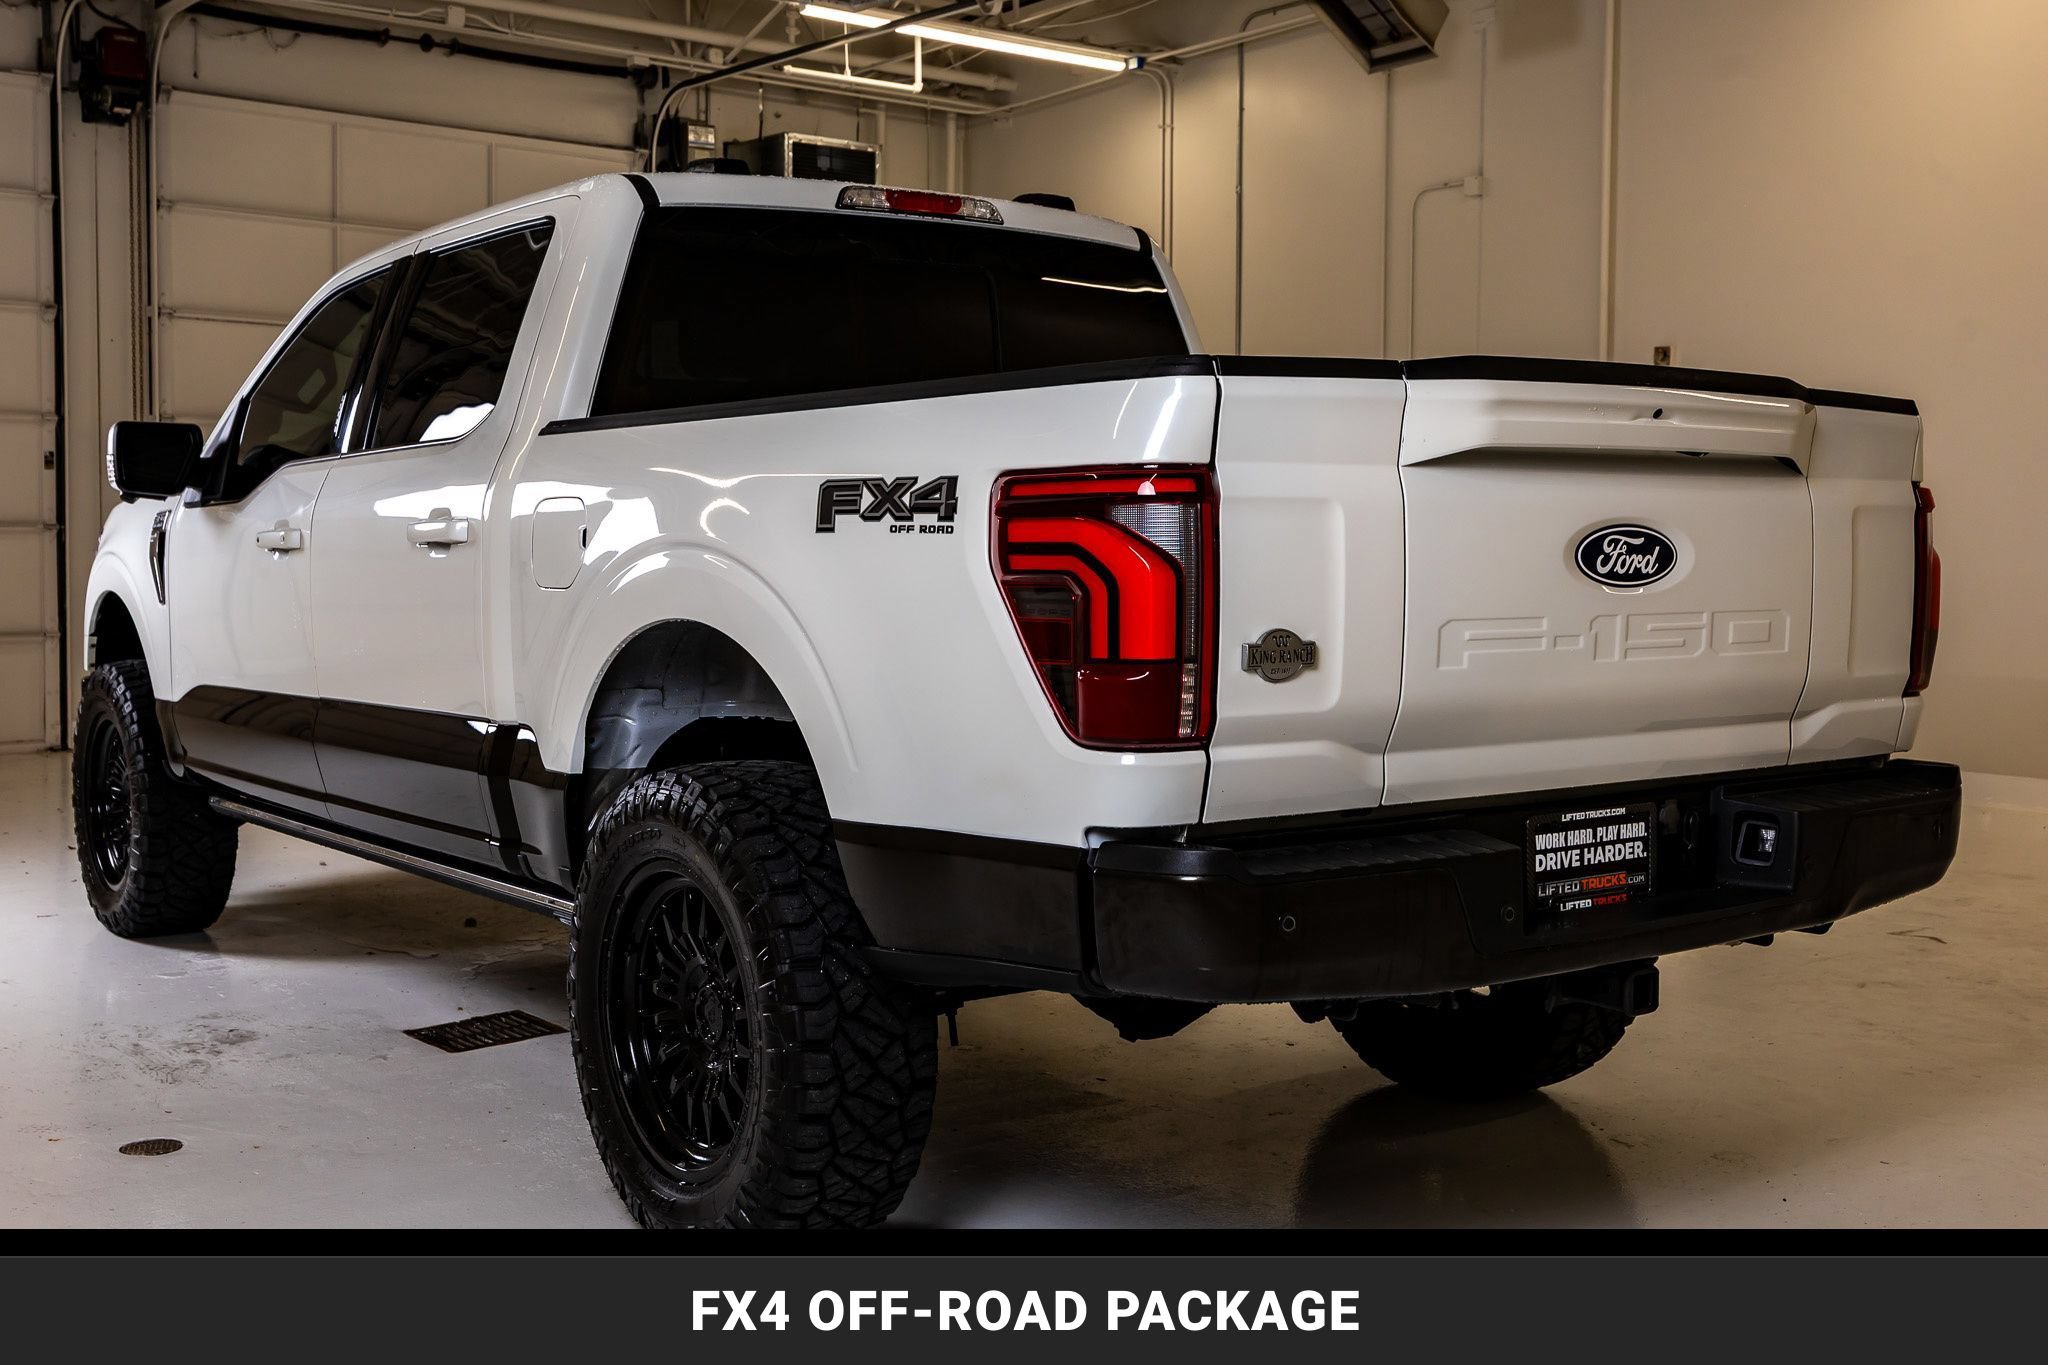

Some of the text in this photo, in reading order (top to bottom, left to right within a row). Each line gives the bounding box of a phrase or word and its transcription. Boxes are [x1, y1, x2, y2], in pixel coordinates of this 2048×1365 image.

[815, 475, 959, 533] FX4
[889, 524, 954, 535] OFF ROAD
[1596, 534, 1660, 575] Ford
[1436, 608, 1791, 669] F-150
[1251, 646, 1313, 665] KING RANCH
[1535, 821, 1648, 851] WORK HARD. PLAY HARD.
[1535, 841, 1647, 872] DRIVE HARDER.
[1560, 899, 1592, 912] LIFTED
